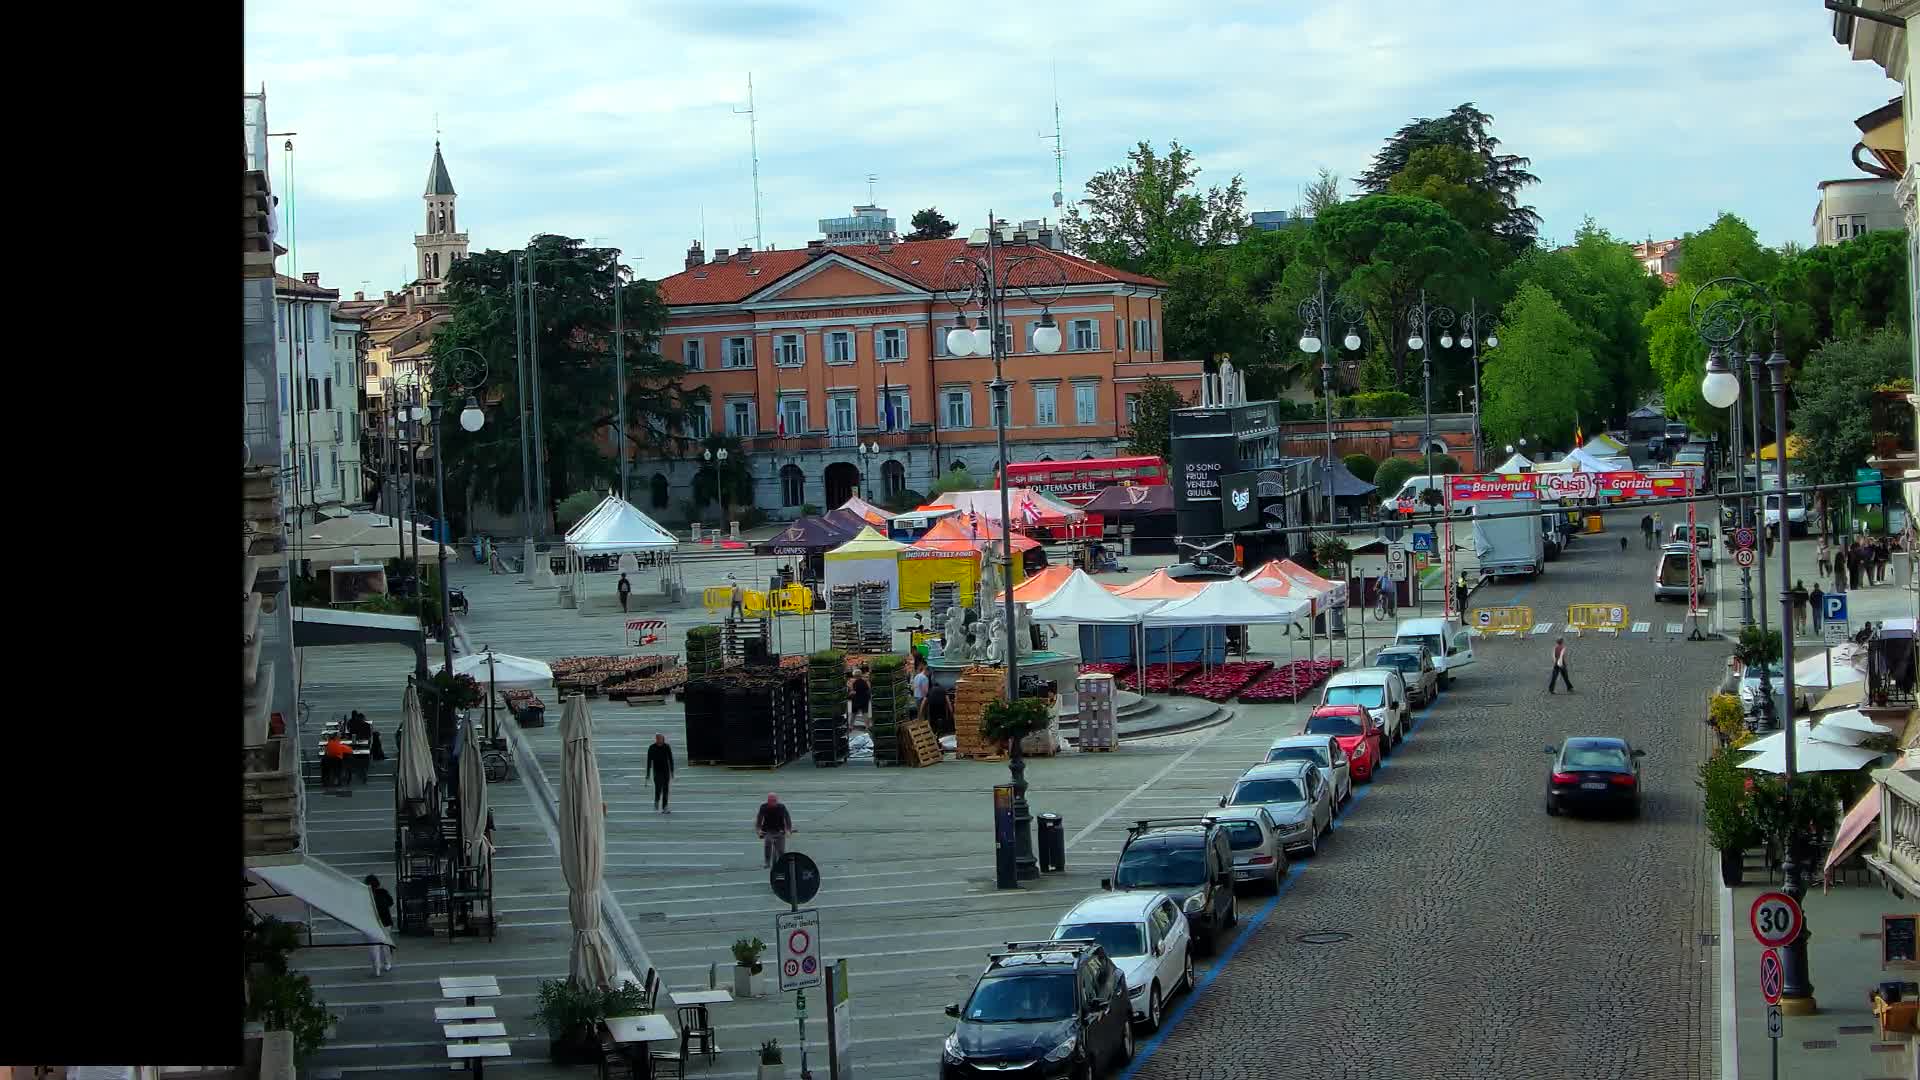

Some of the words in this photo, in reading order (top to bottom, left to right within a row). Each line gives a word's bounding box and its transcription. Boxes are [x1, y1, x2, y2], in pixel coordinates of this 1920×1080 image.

[1185, 463, 1195, 472] IO
[1196, 463, 1221, 471] SONO
[1186, 472, 1208, 480] FRIULI
[1186, 480, 1219, 488] VENEZIA
[1472, 479, 1531, 492] Benvenuti
[1611, 478, 1653, 489] Gorizia
[1187, 488, 1213, 497] GIULIA
[773, 546, 807, 555] GUINNESS
[1739, 552, 1751, 562] 20
[1827, 598, 1843, 618] P
[1759, 907, 1790, 933] 30
